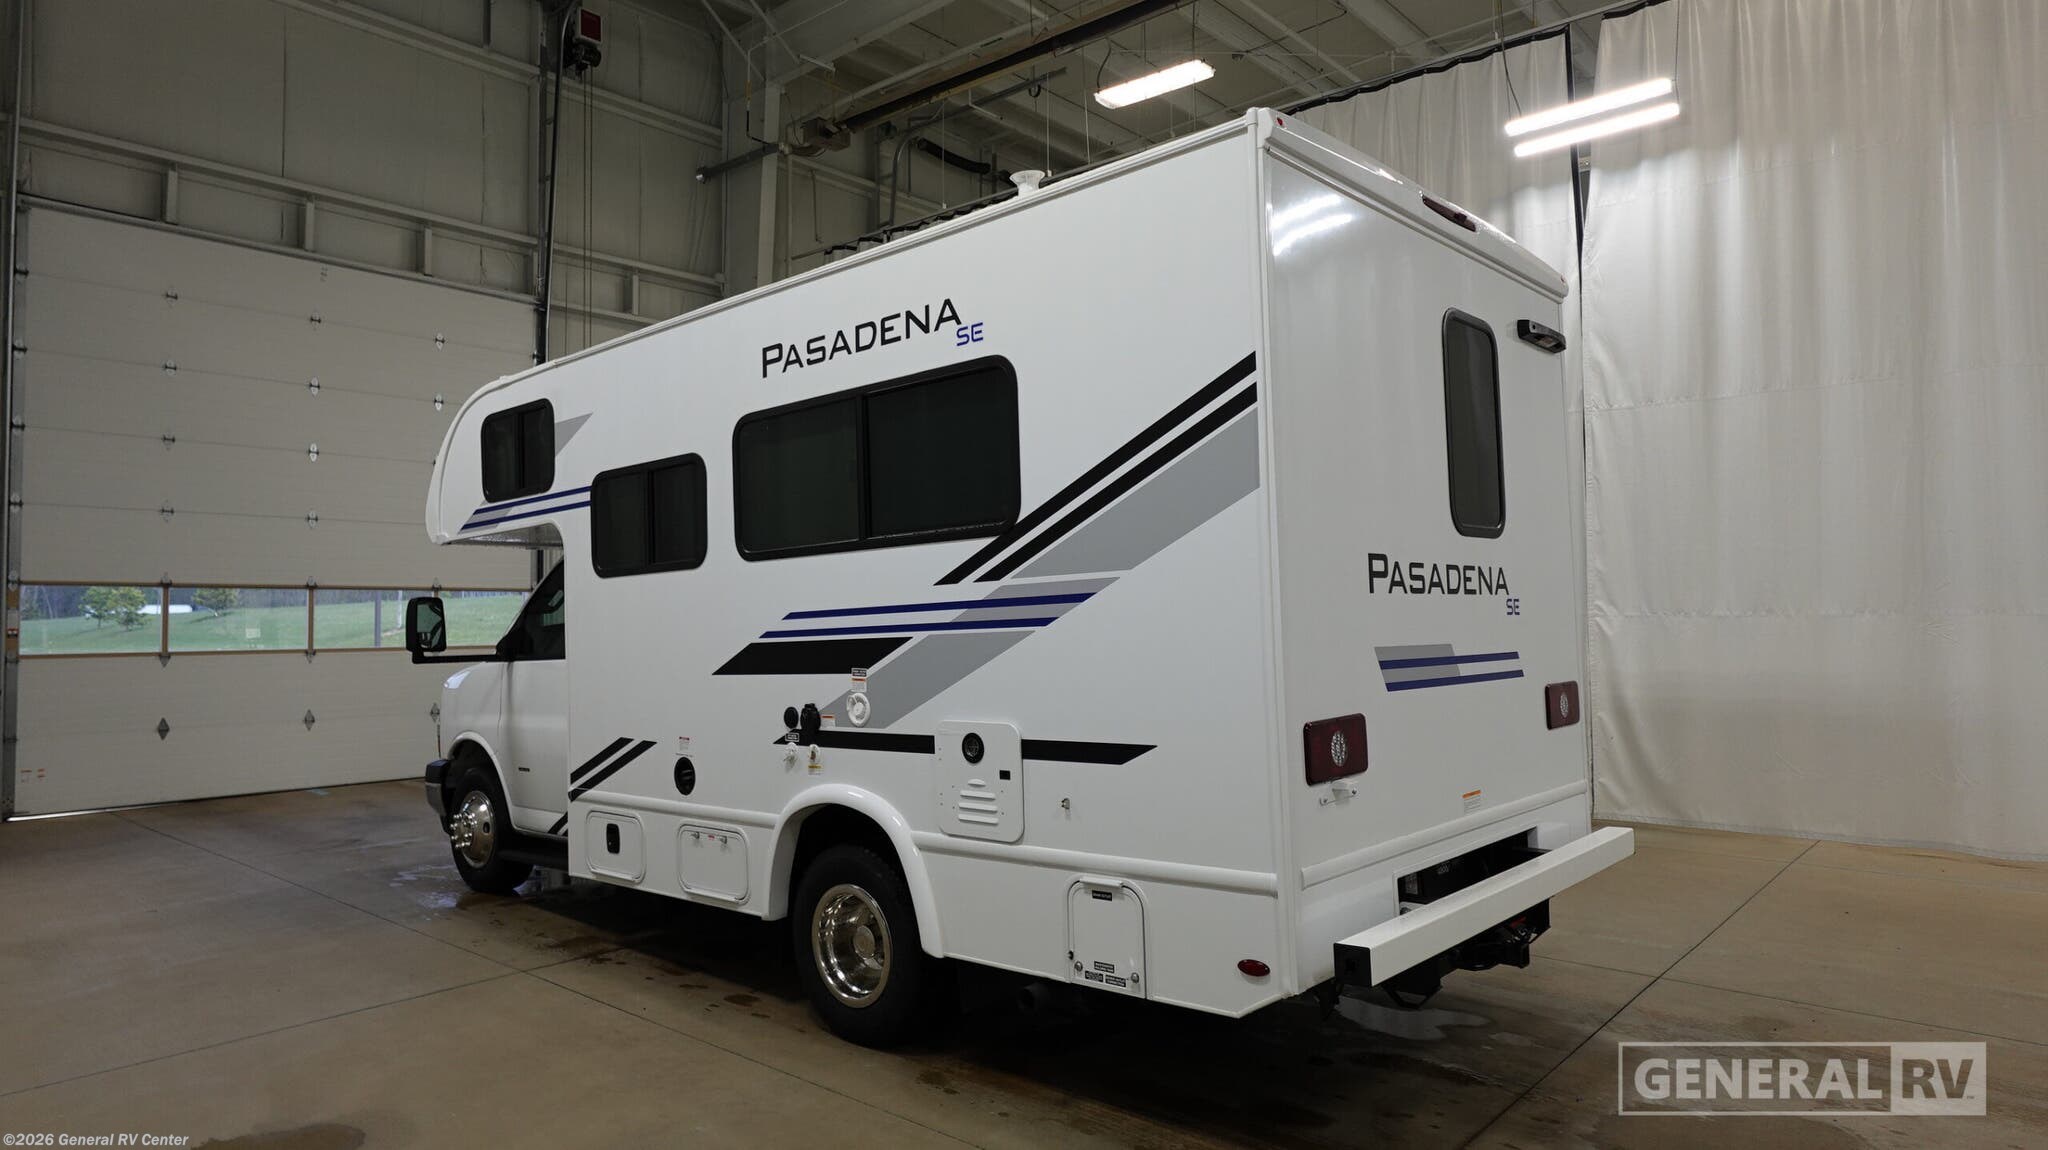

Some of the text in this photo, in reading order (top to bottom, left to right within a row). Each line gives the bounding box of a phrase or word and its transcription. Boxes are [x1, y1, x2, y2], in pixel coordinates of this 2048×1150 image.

[762, 298, 962, 379] PASADENA
[956, 322, 984, 347] SE
[1367, 553, 1510, 596] PASADENA
[1506, 598, 1521, 616] SE
